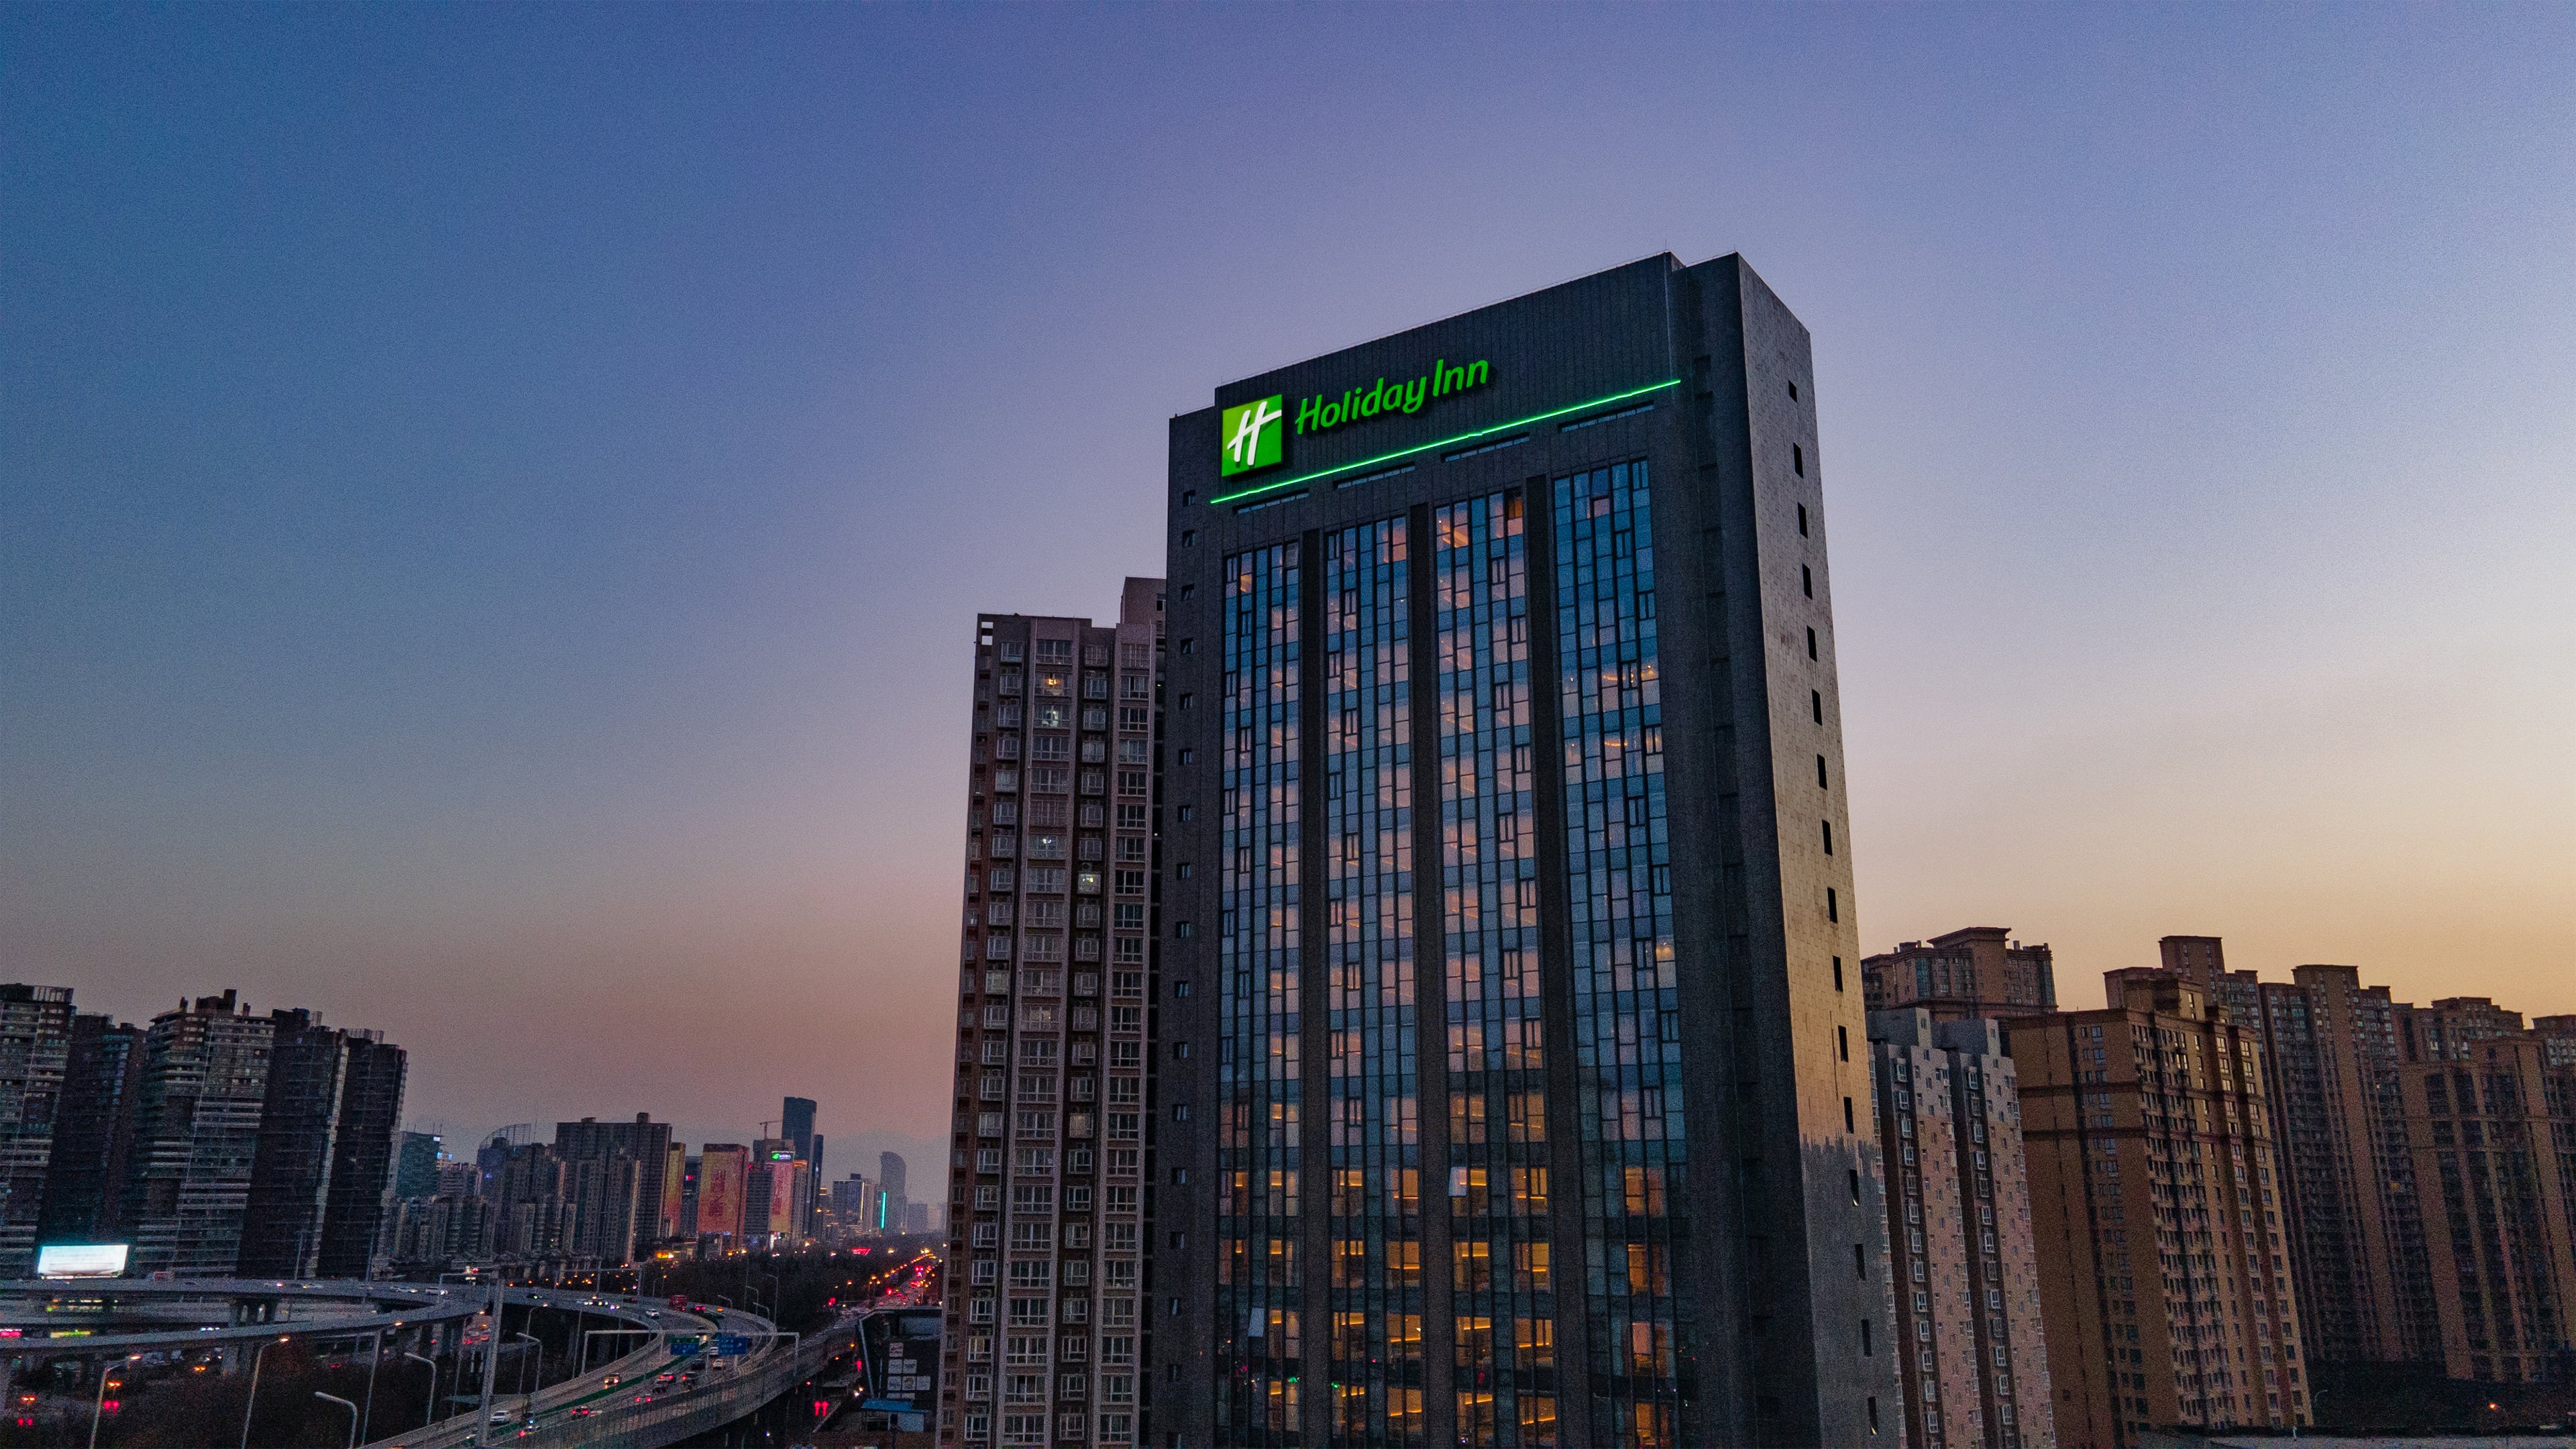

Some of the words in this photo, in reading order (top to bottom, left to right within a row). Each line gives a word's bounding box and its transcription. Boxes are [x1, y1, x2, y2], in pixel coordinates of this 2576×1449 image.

[1295, 376, 1427, 435] Holiday
[1432, 359, 1489, 397] Inn
[1227, 400, 1282, 466] H
